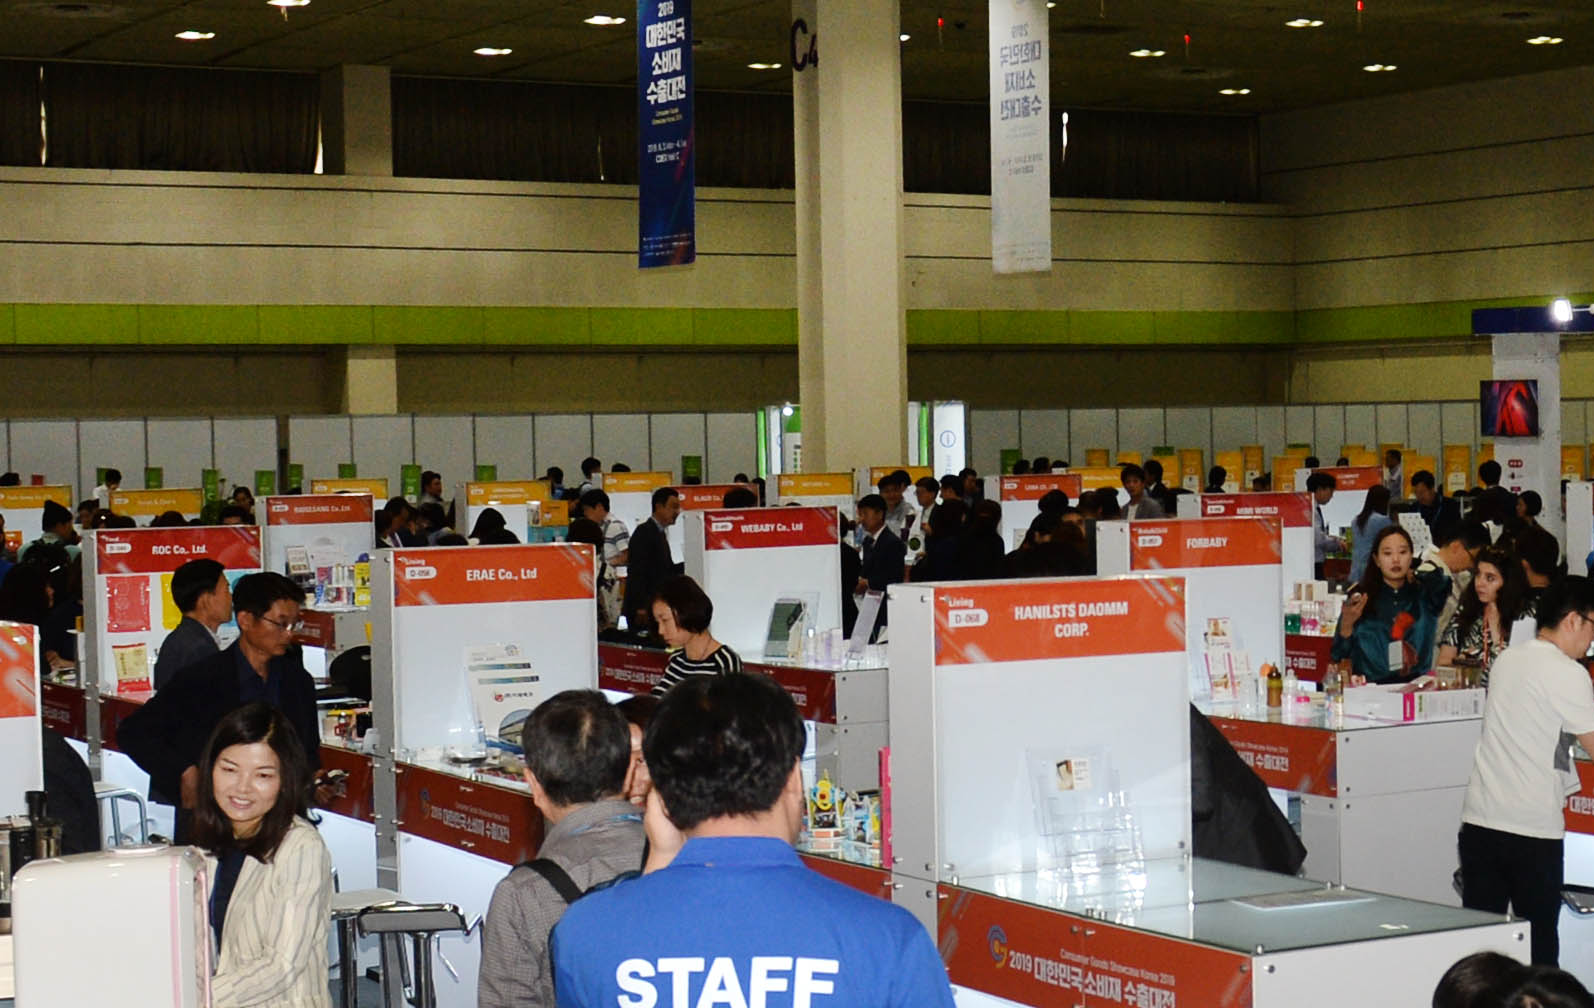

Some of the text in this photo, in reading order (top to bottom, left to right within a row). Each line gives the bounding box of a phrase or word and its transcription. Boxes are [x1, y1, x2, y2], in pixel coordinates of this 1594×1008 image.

[658, 1, 674, 17] 2019
[645, 17, 686, 48] 대한민국
[652, 48, 682, 76] 소비재
[646, 75, 686, 105] 수출대전
[466, 569, 496, 582] ERAE
[520, 567, 537, 579] Ltd
[1014, 603, 1077, 621] HANILSTS
[1055, 623, 1090, 638] CORP.
[1009, 951, 1032, 974] 2019
[1034, 957, 1083, 993] 대한민국
[1084, 973, 1122, 1004] 소비재
